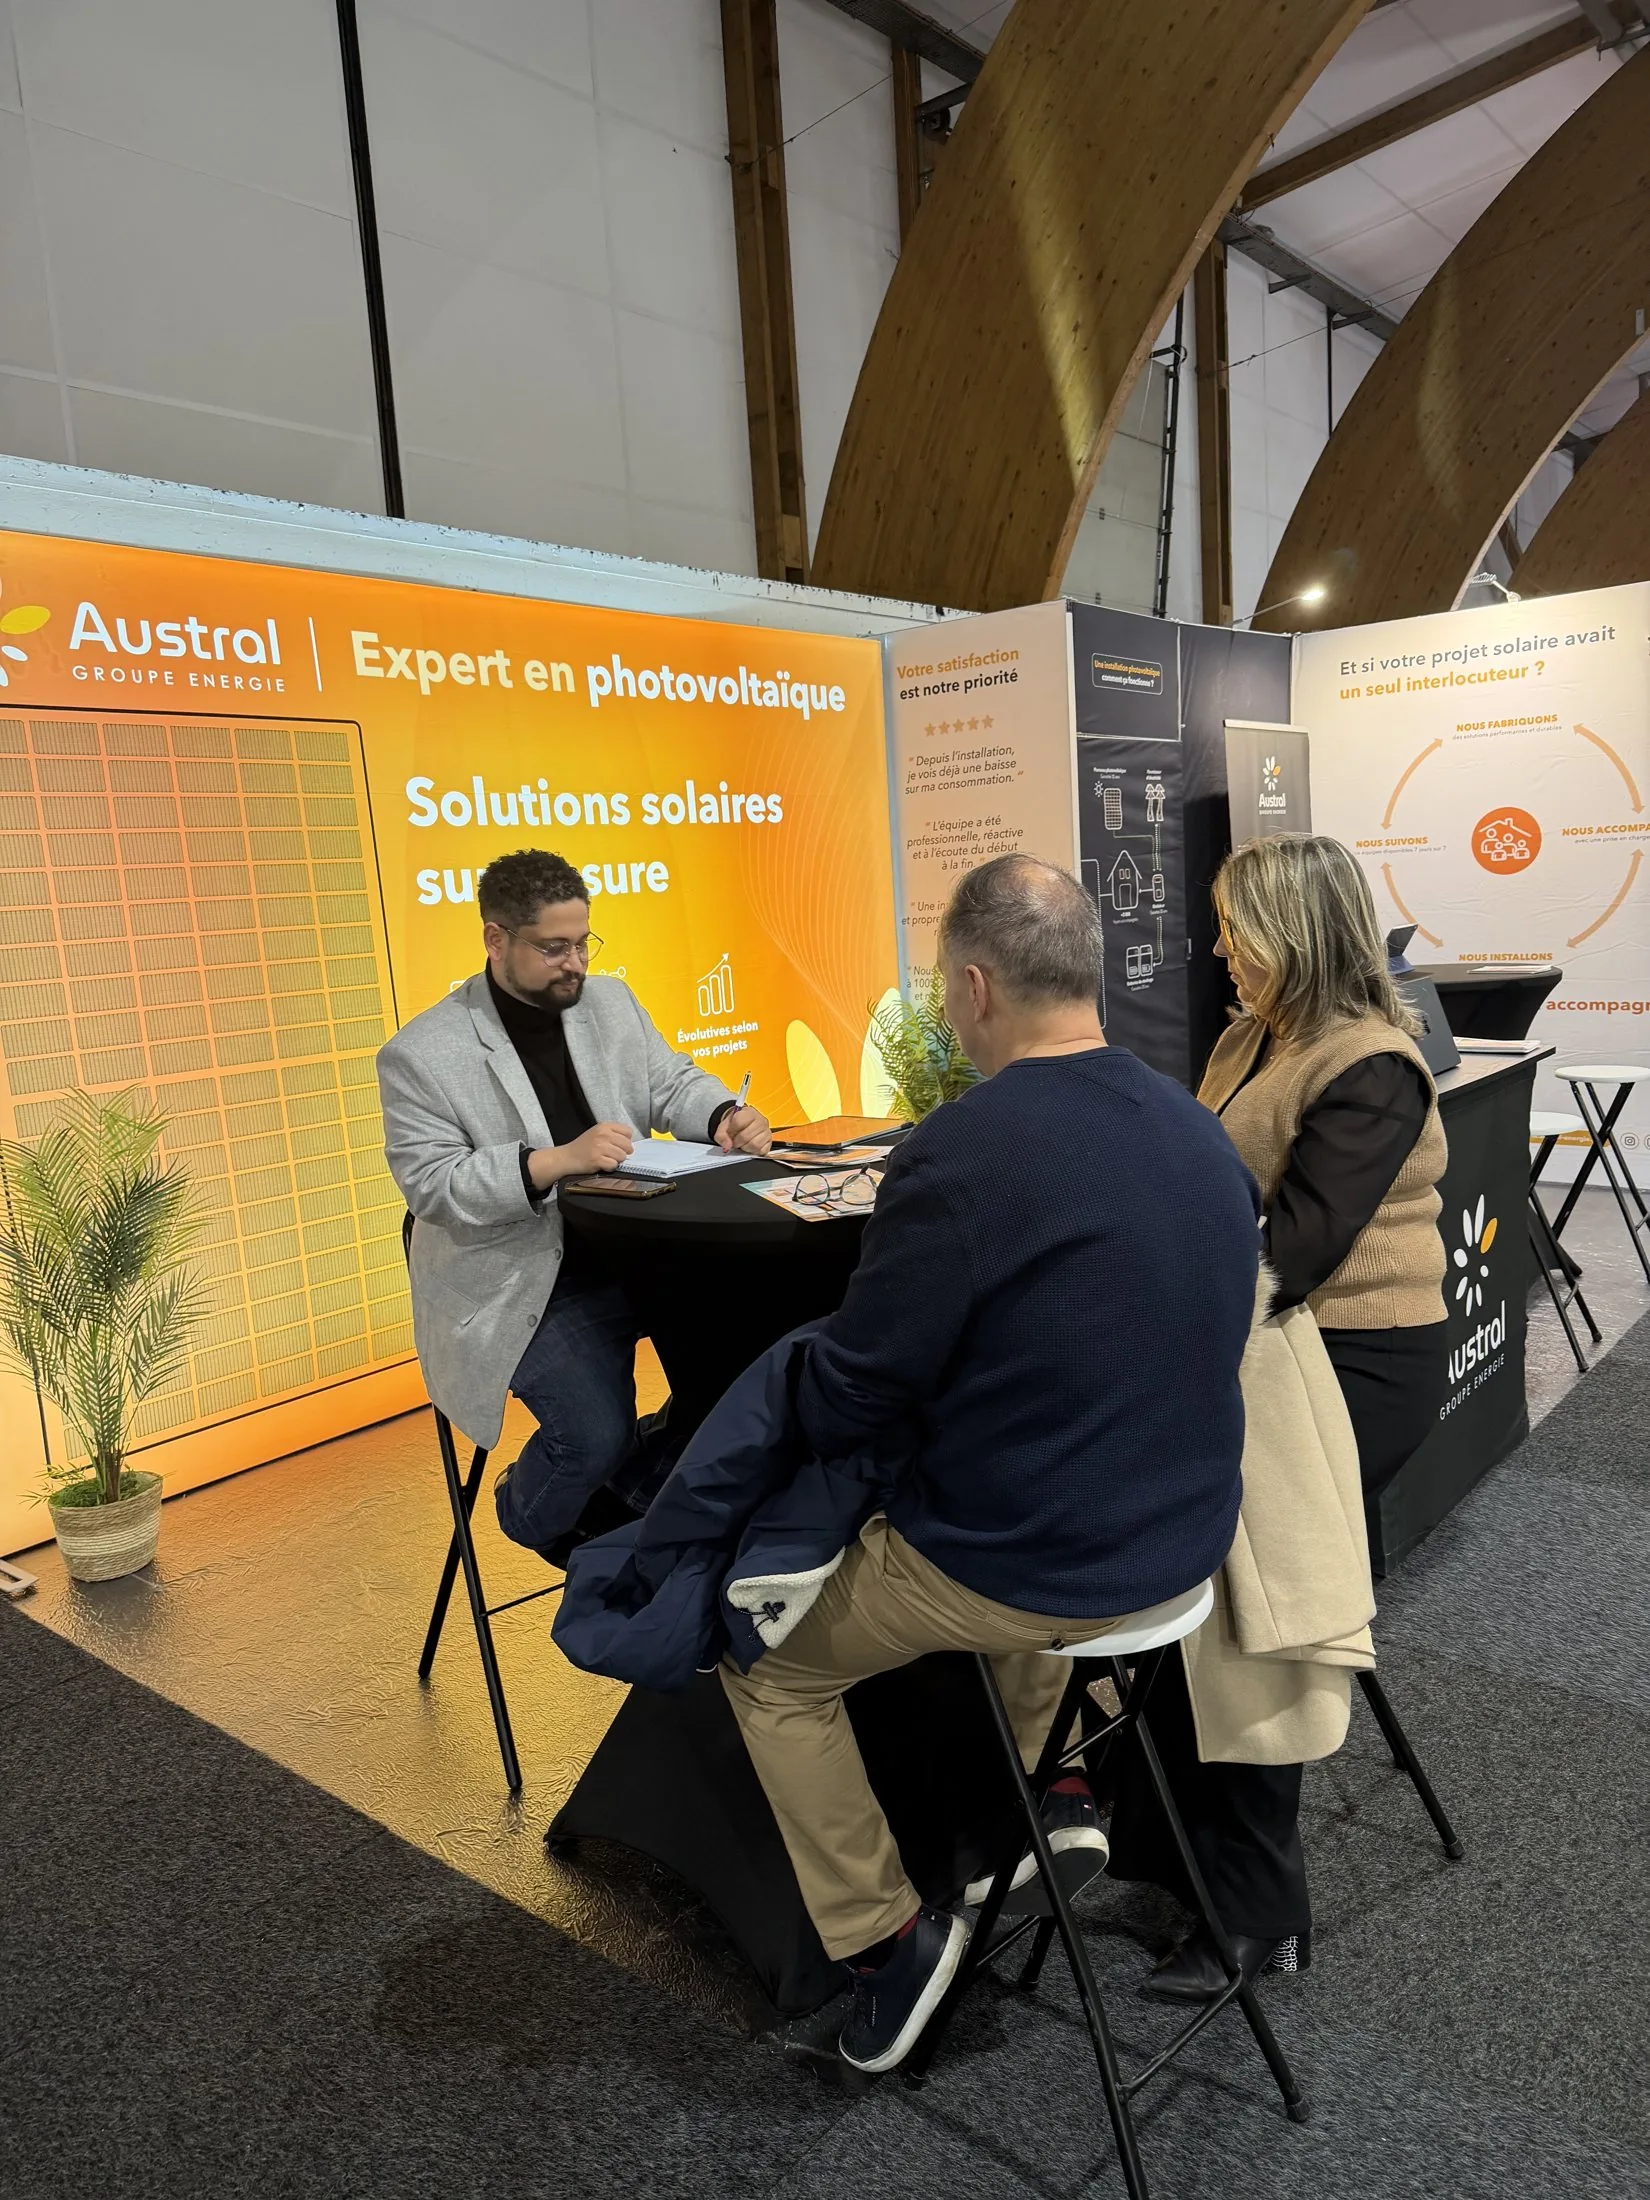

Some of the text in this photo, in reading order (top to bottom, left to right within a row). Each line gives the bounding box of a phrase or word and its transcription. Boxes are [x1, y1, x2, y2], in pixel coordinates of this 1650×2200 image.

[69, 601, 283, 666] Austral
[1340, 625, 1616, 675] Et si votre projet solaire avait
[350, 630, 847, 720] Expert en photovoltaïque
[896, 649, 1020, 680] Votre satisfaction
[71, 665, 286, 693] GROUPE ENERGIE
[900, 667, 1018, 700] est notre priorité
[1340, 660, 1546, 700] un seul interlocuteur ?
[1456, 714, 1558, 732] NOUS FABRIQUONS
[916, 752, 950, 767] Depuis
[907, 759, 1017, 784] je vois déjà une baisse
[905, 784, 920, 795] sur
[920, 783, 936, 793] ma
[937, 773, 1015, 791] consommation.
[405, 775, 784, 828] Solutions solaires
[1259, 792, 1286, 808] Austral
[976, 819, 983, 827] a
[984, 814, 1002, 827] été
[1562, 826, 1594, 837] NOUS
[907, 827, 1024, 850] professionnelle, réactive
[1355, 836, 1429, 848] NOUS SUIVONS
[912, 850, 922, 860] et
[923, 848, 929, 859] à
[970, 843, 985, 855] du
[986, 841, 1019, 853] début
[941, 860, 948, 871] à
[950, 859, 959, 870] la
[581, 860, 670, 897] sure
[917, 900, 935, 912] Une
[901, 916, 911, 926] et
[1458, 952, 1553, 961] NOUS INSTALLONS
[676, 1020, 759, 1044] Évolutives selon
[692, 1039, 748, 1058] vos projets
[1439, 1352, 1505, 1421] GROUPE ENERGIE
